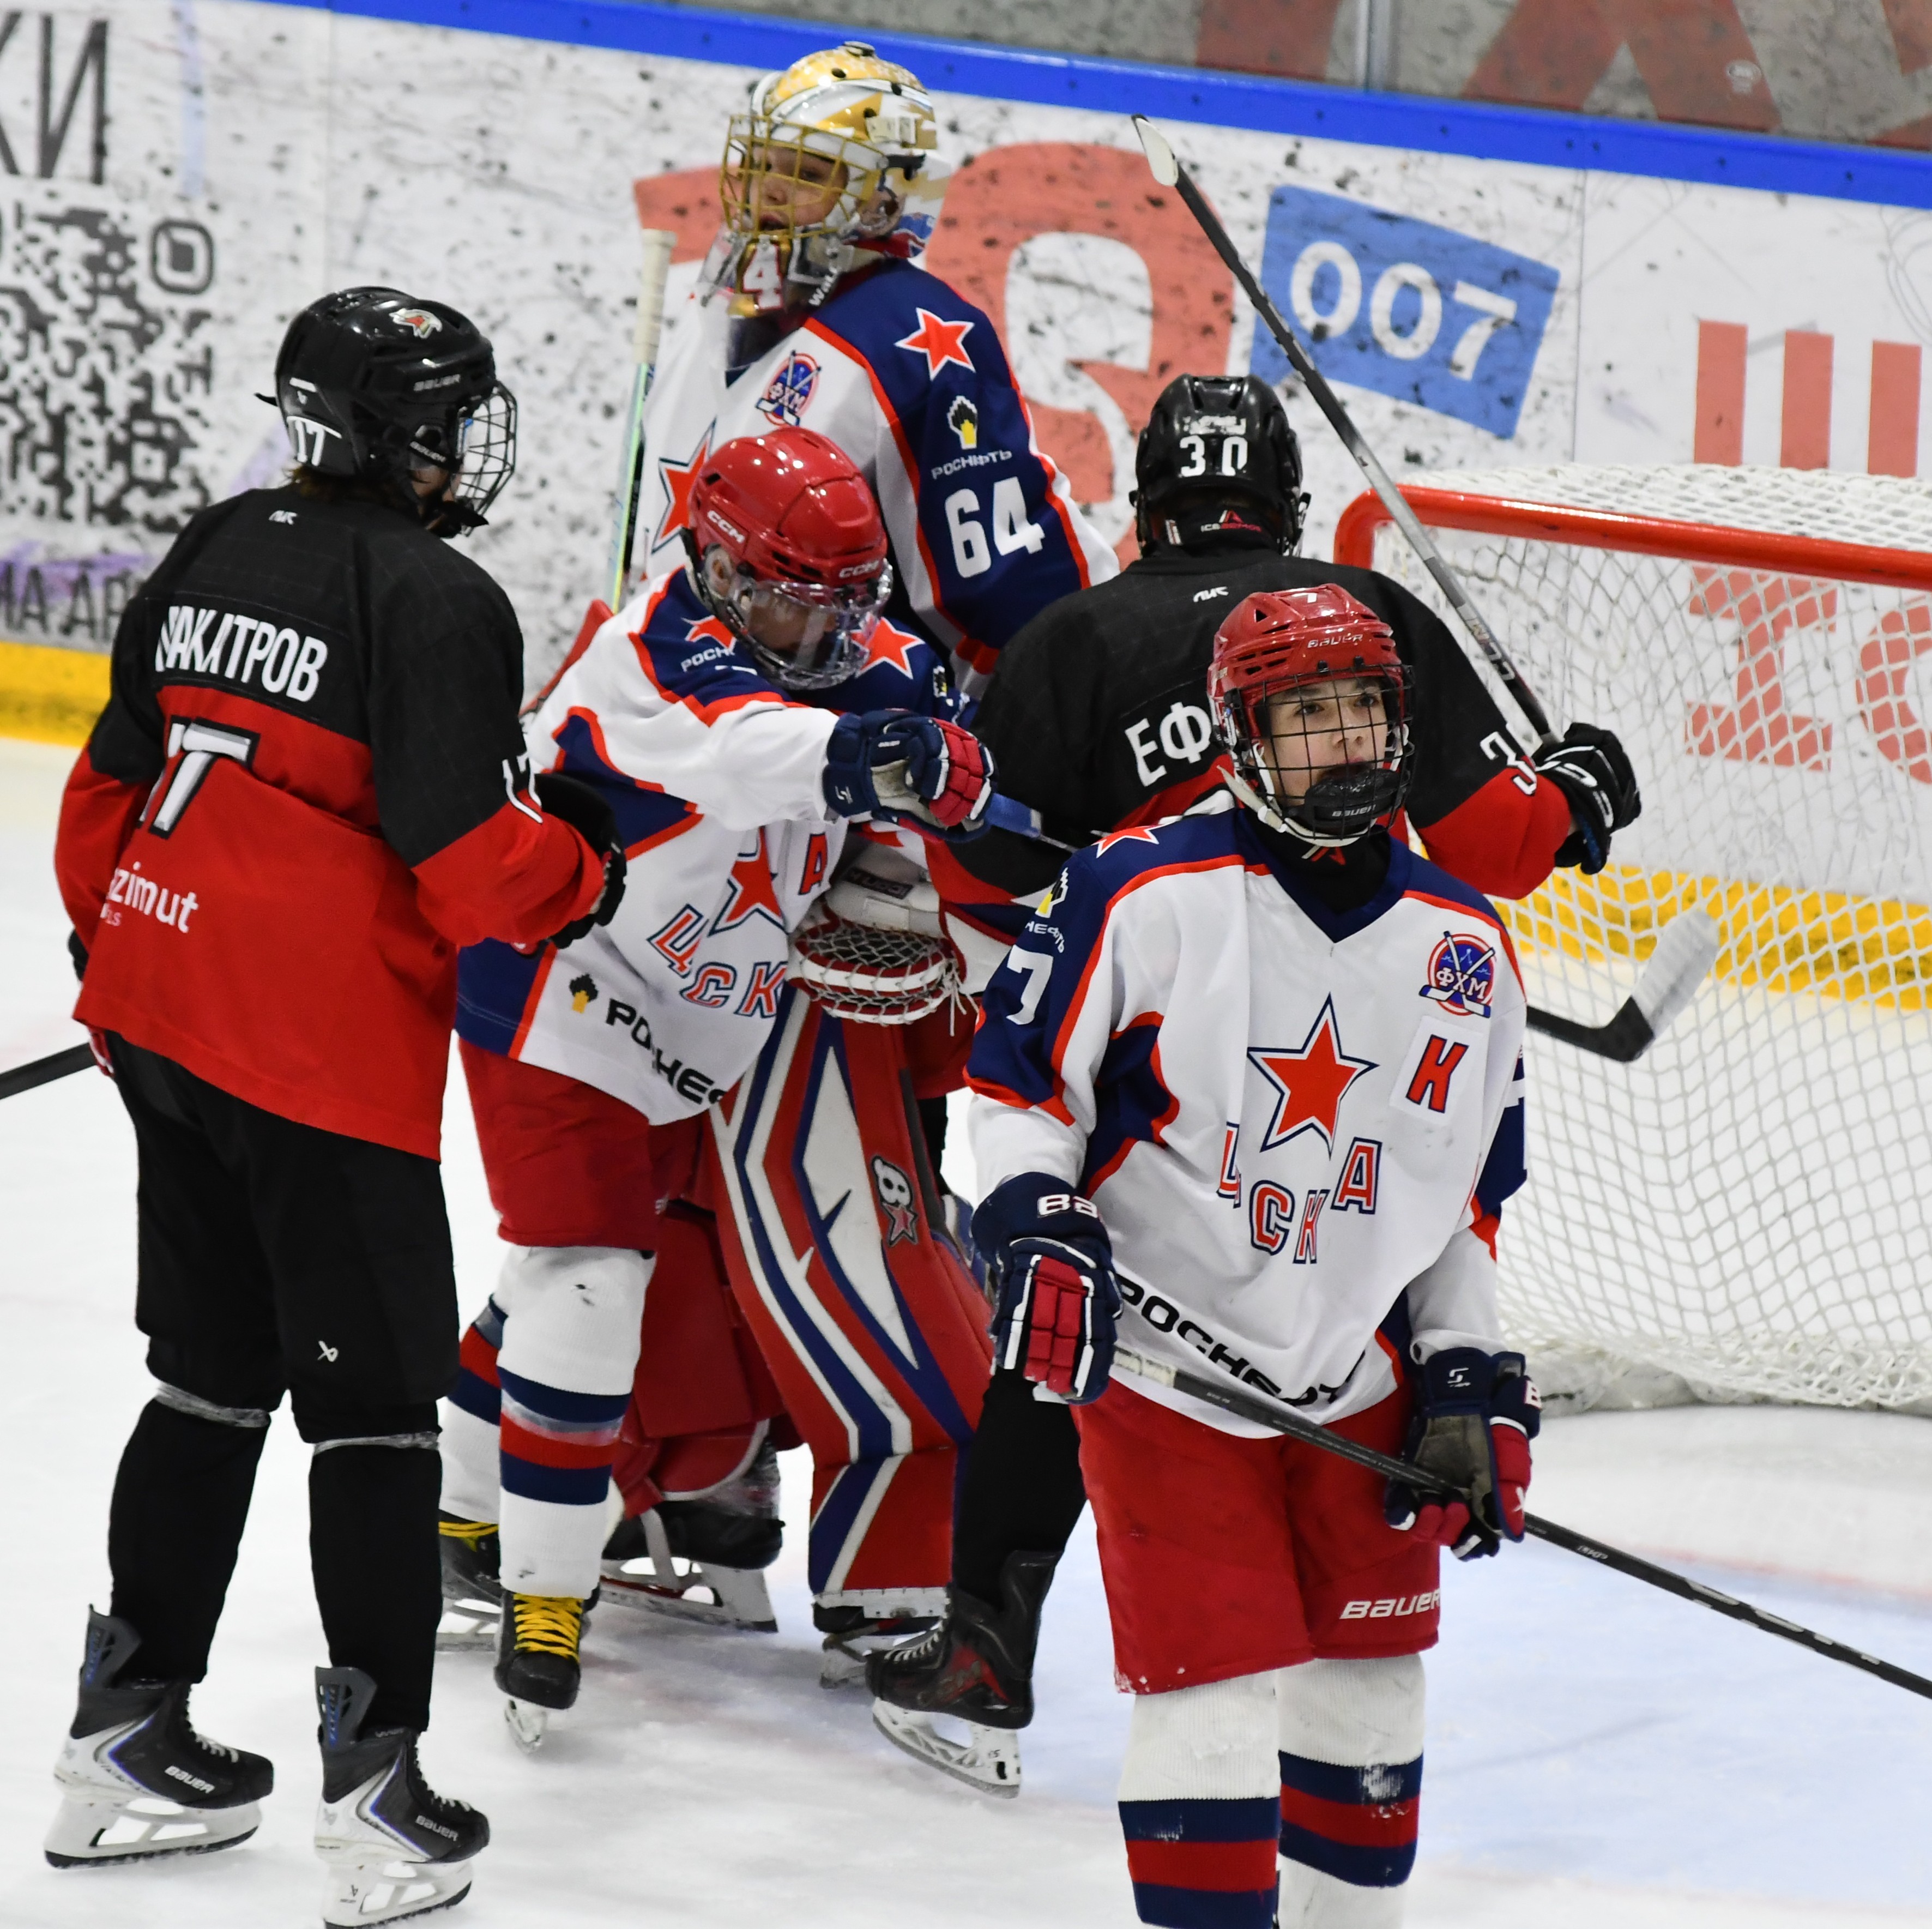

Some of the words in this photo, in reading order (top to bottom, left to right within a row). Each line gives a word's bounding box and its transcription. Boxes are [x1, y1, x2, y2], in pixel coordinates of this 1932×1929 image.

[0, 11, 108, 185] И
[1290, 240, 1518, 381] 007
[1180, 435, 1249, 478] 30
[707, 510, 746, 544] CCM
[945, 477, 1046, 578] 64
[838, 559, 879, 578] CCM
[1307, 634, 1363, 648] BAUER
[1332, 804, 1377, 818] BAUER
[108, 860, 200, 933] zimut
[1006, 944, 1054, 1026] 7
[1435, 967, 1489, 999] ФХМ
[1216, 1120, 1383, 1264] ЦСКА
[164, 1765, 215, 1794] BAUER
[415, 1815, 460, 1842] BAUER
